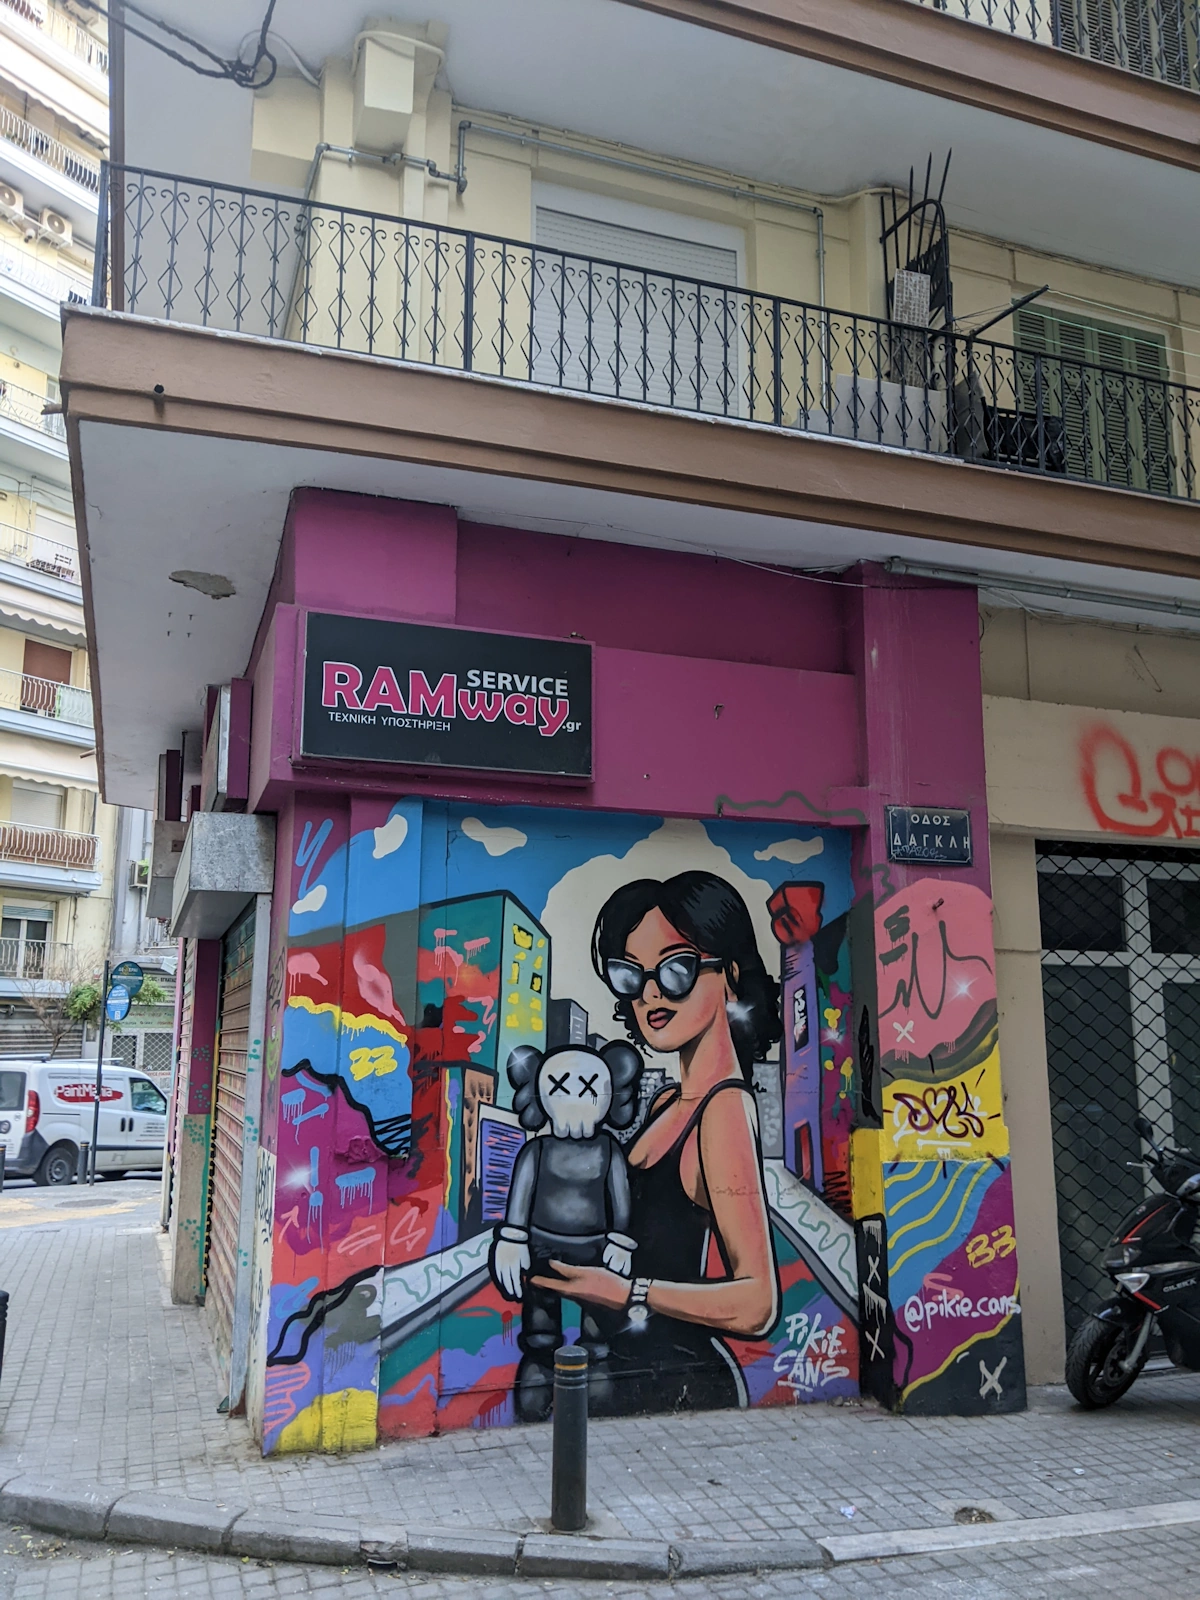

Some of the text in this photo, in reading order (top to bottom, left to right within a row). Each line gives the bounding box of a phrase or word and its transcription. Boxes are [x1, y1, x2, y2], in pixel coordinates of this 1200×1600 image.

[467, 669, 568, 696] SERVICE
[328, 711, 451, 732] ΤΕΧΝΙΚΗ ΥΠΟΣΤΗΡΙΞΗ
[911, 814, 951, 826] ΟΔΟΣ
[893, 832, 969, 849] ΔΑΓΚΛΗ
[55, 1084, 113, 1098] PaintMaia
[904, 1288, 1022, 1333] @pikie_cans
[773, 1349, 850, 1387] CANS
